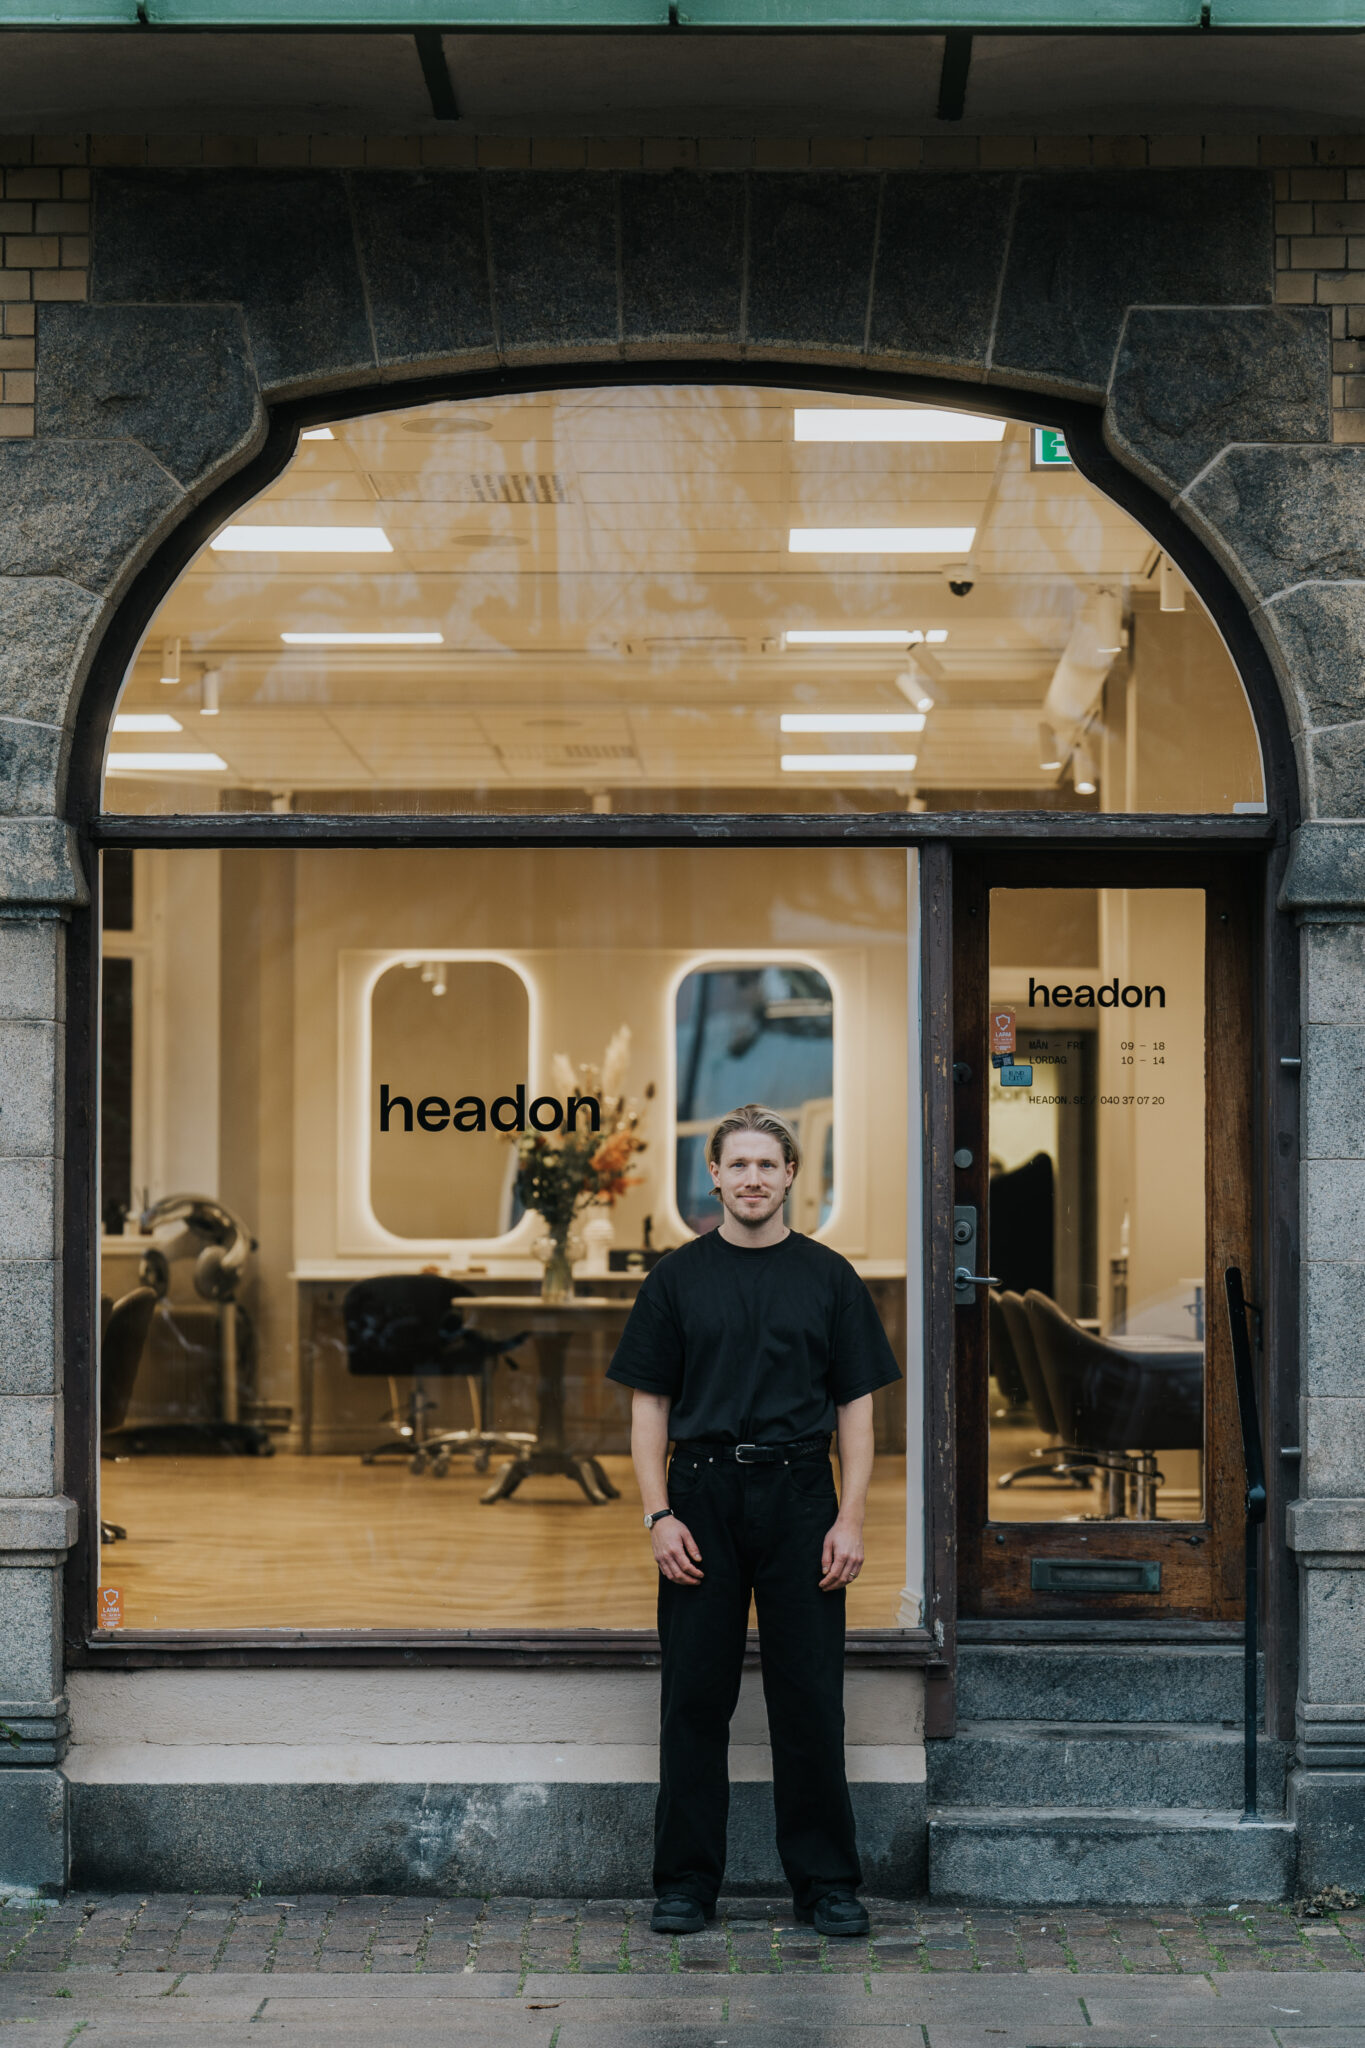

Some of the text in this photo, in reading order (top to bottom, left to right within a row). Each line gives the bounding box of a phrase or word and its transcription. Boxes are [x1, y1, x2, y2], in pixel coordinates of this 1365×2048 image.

[1029, 978, 1165, 1008] headon
[1121, 1042, 1134, 1050] 09
[1153, 1042, 1165, 1050] 18
[1121, 1056, 1134, 1065] 10
[1153, 1056, 1165, 1065] 14
[1029, 1096, 1086, 1105] HEADON.SE
[1100, 1096, 1120, 1105] 040
[1122, 1096, 1135, 1105] 37
[1137, 1096, 1149, 1105] 07
[1152, 1096, 1165, 1105] 20
[380, 1084, 600, 1132] headon
